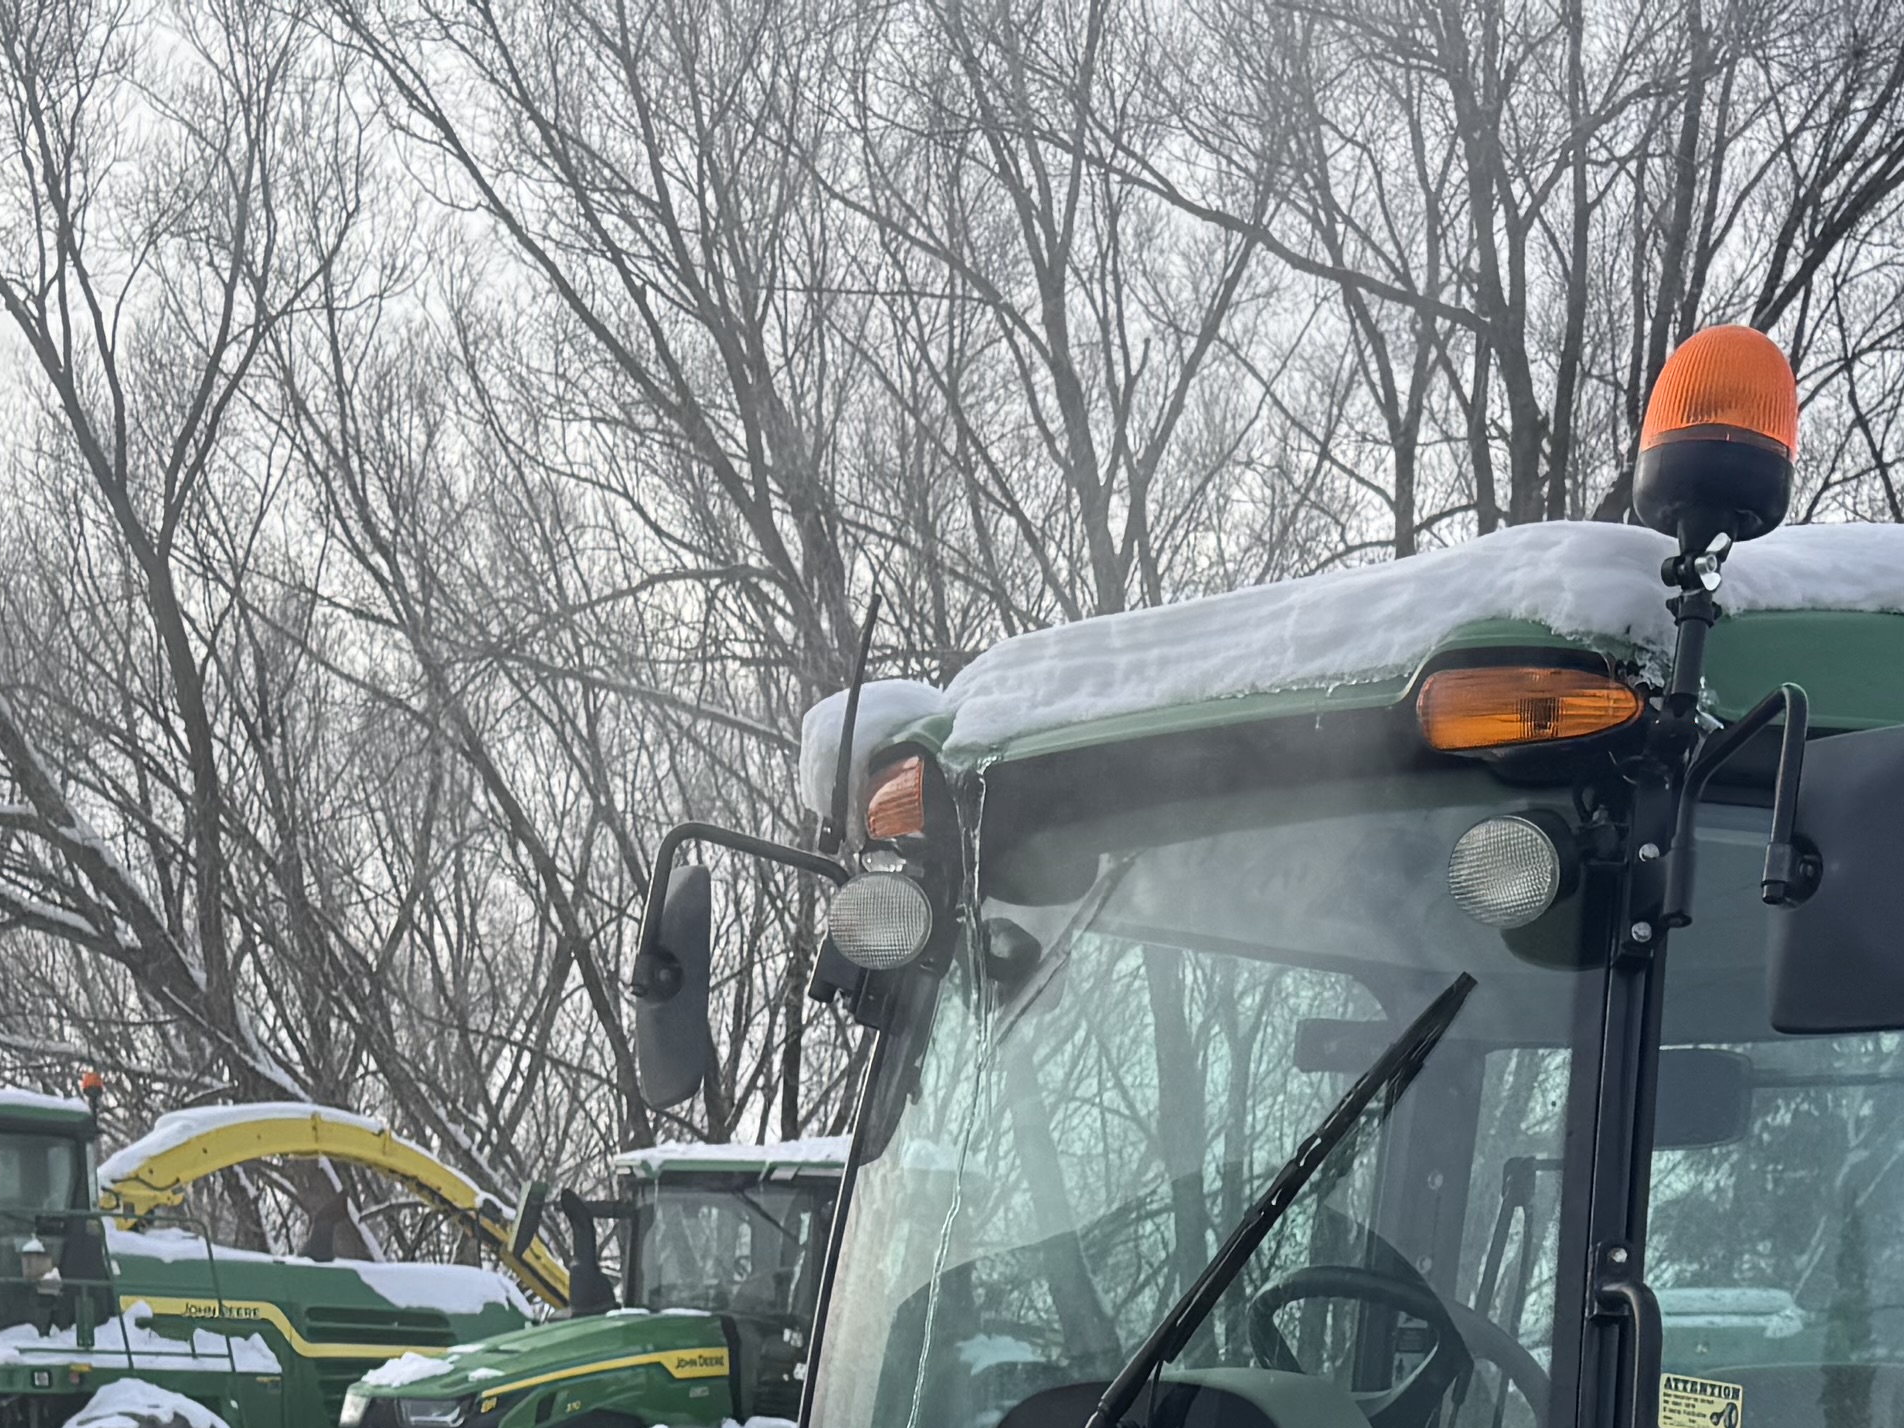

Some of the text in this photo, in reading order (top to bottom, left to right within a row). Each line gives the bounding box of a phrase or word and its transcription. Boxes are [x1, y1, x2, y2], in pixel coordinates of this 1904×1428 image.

[185, 1302, 217, 1316] JOHN
[675, 1355, 725, 1369] JOHN DEERE
[1663, 1376, 1741, 1400] ATTENTION
